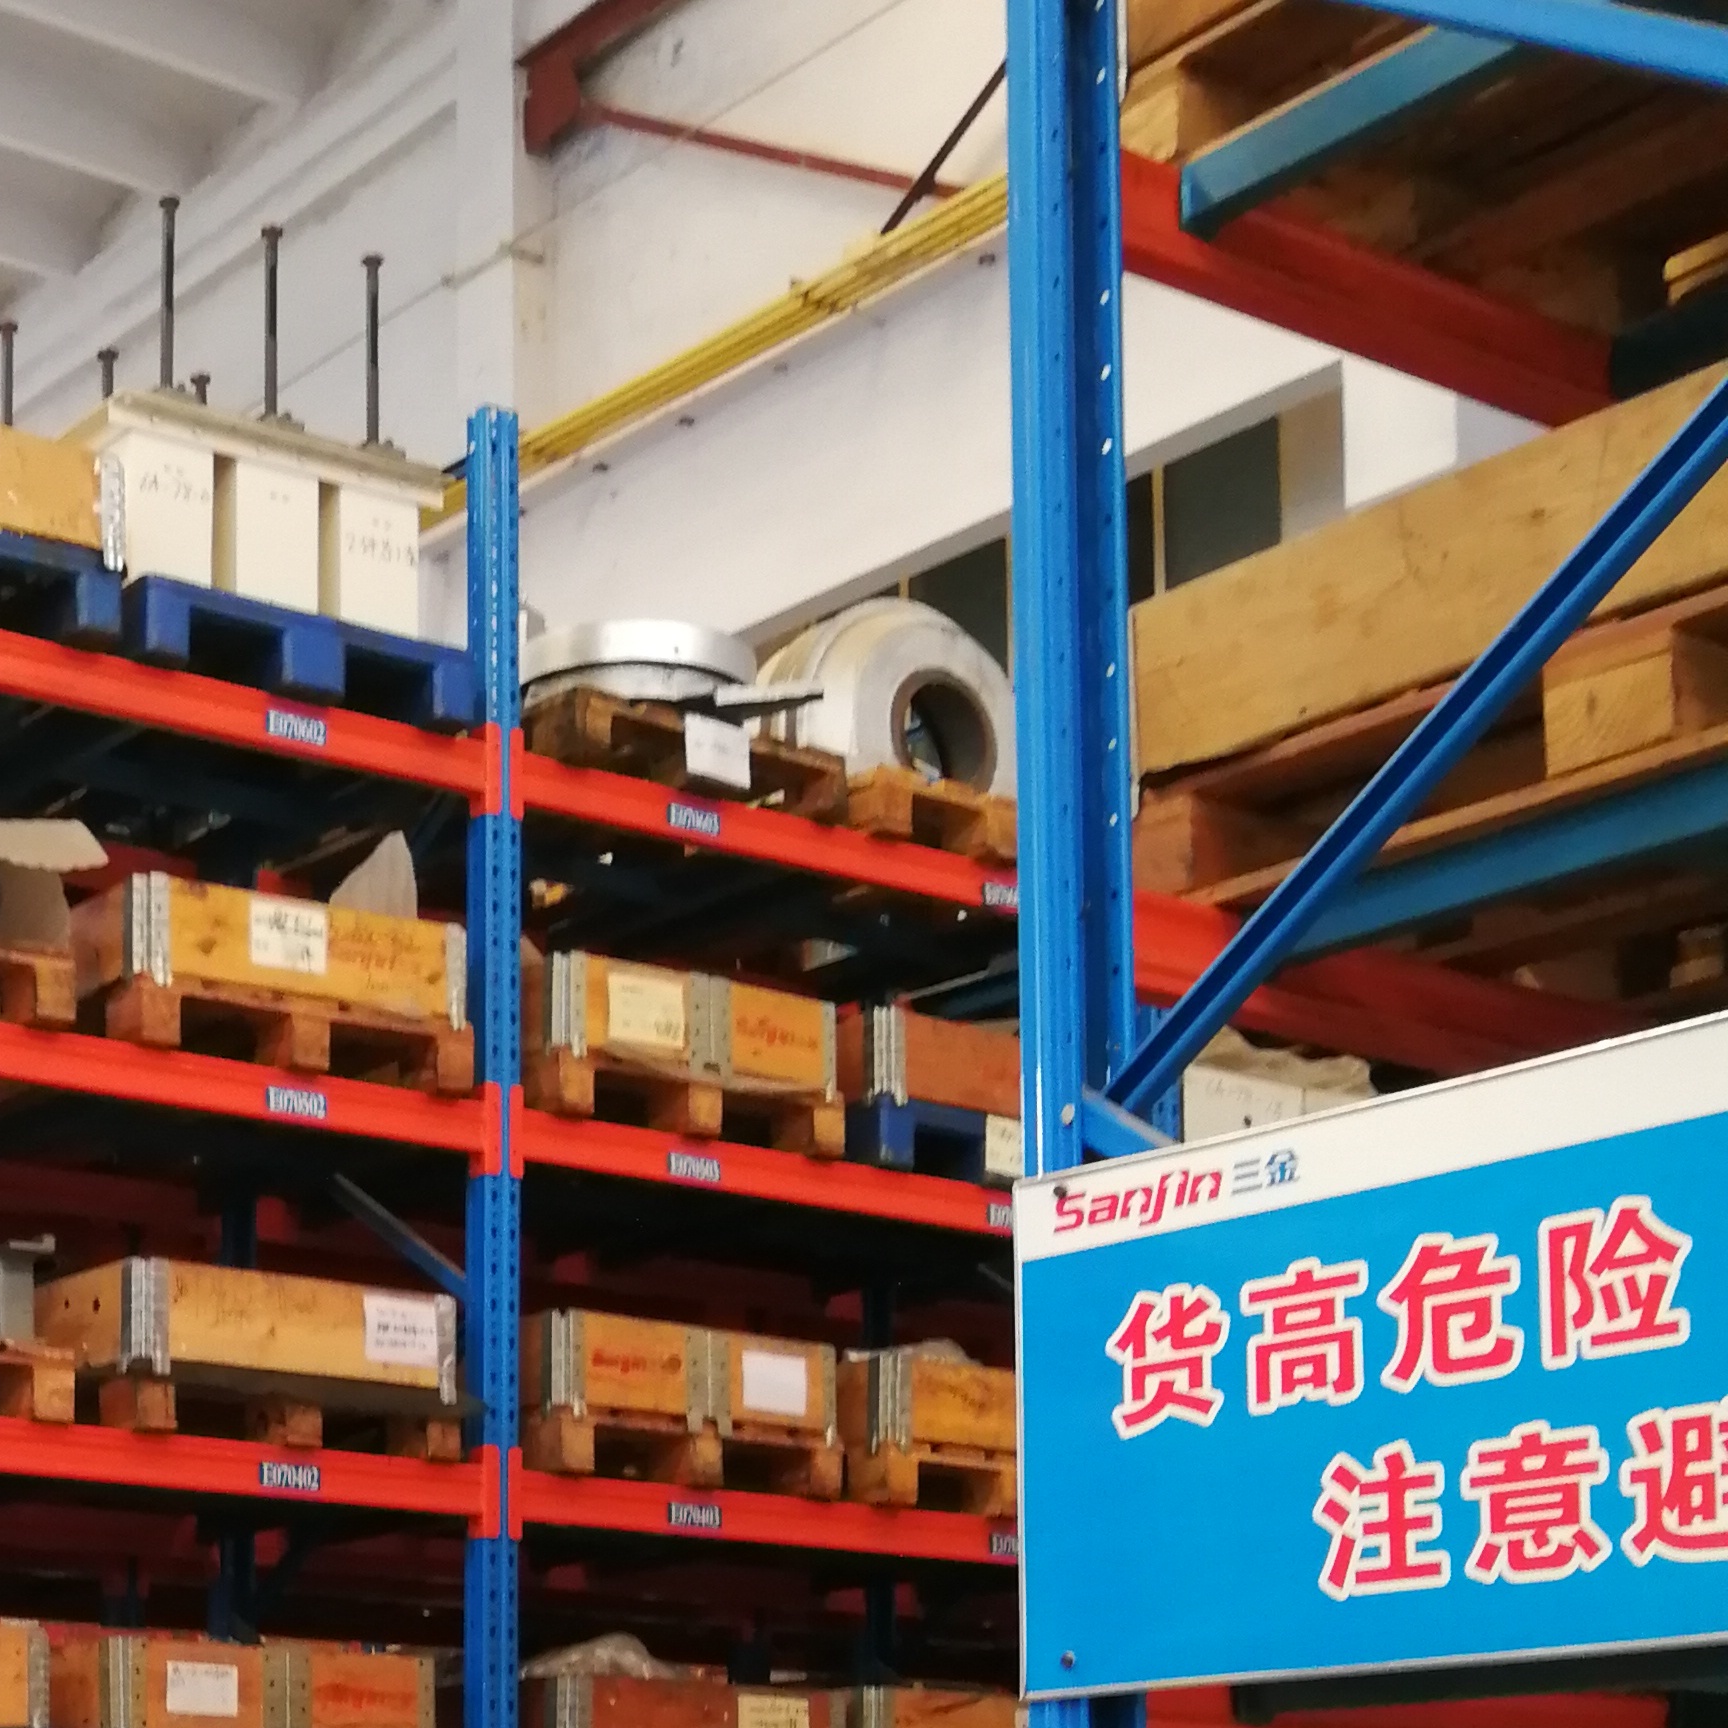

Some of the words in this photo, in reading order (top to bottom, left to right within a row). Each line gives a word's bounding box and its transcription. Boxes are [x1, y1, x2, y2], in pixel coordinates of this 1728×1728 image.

[268, 710, 326, 746] E070602
[268, 1085, 325, 1120] E070502
[1053, 1170, 1222, 1233] Sanjin
[1231, 1148, 1300, 1197] 三金
[1113, 1202, 1685, 1432] 货高危险
[261, 1462, 320, 1491] E070402
